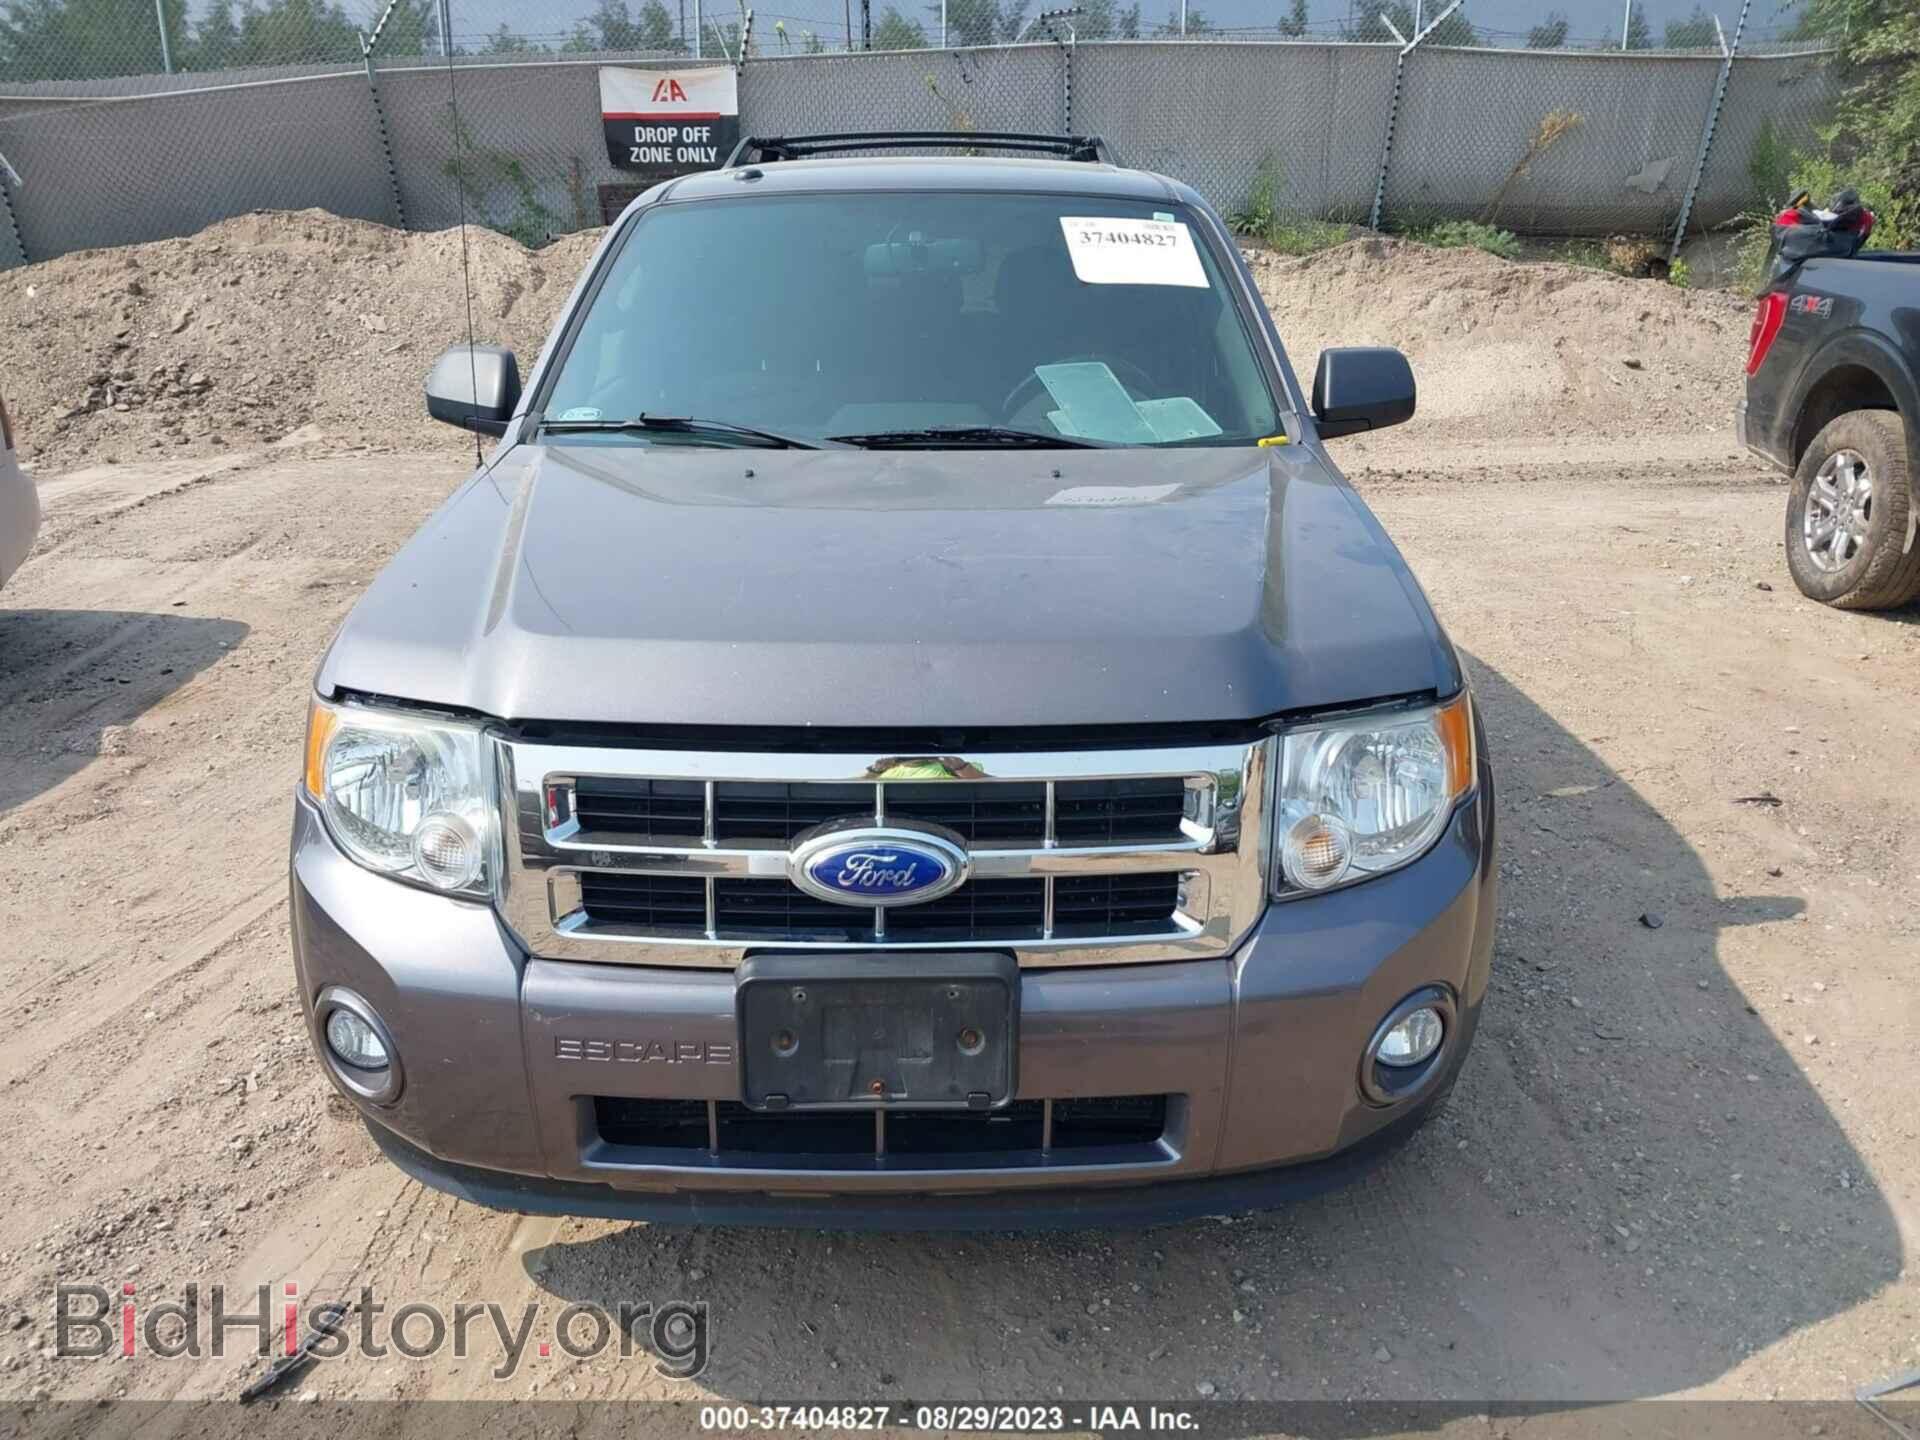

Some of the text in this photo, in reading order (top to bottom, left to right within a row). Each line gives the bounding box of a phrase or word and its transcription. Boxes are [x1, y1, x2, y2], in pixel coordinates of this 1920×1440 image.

[634, 126, 711, 143] DROP OFF
[630, 147, 717, 163] ZONE ONLY
[1079, 231, 1177, 247] 37404827
[837, 853, 917, 887] Ford
[554, 1036, 732, 1064] ESCAPE
